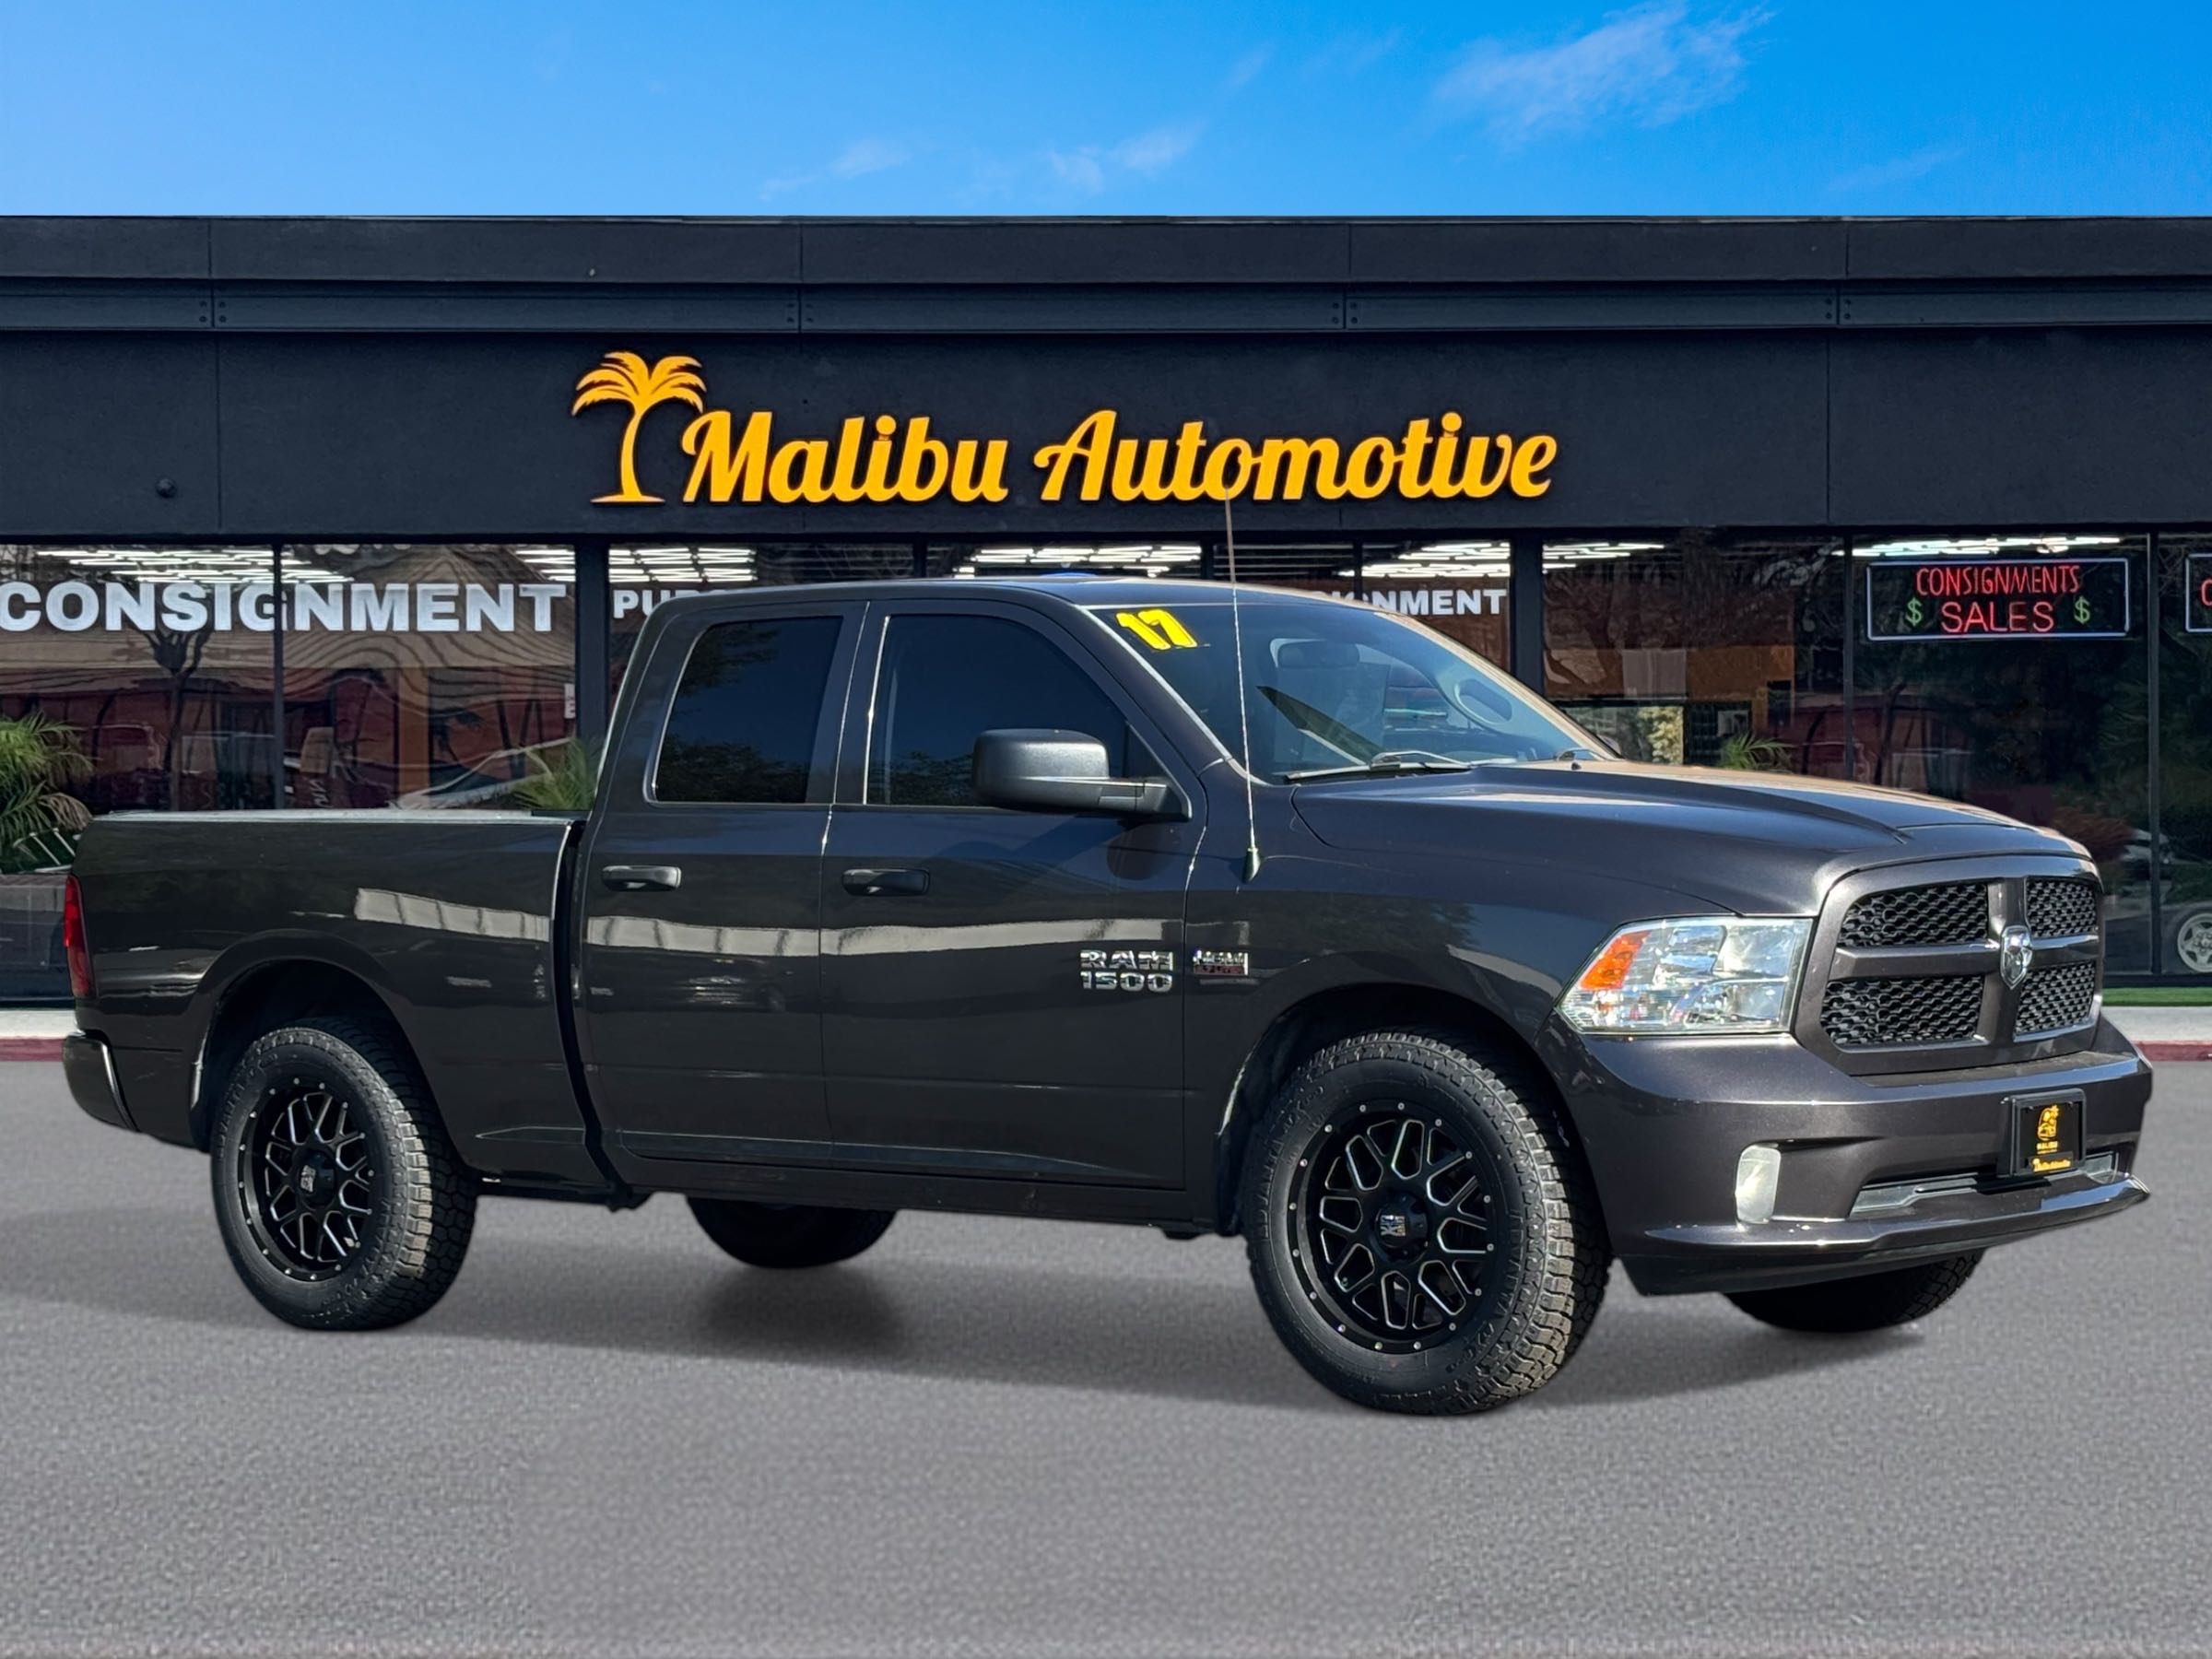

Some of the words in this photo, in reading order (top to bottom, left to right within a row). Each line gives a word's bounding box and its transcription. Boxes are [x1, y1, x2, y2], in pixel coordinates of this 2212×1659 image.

[681, 410, 1010, 504] Malibu
[1033, 408, 1558, 502] Automotive
[1915, 564, 2081, 596] CONSIGNMENTS
[0, 582, 567, 632] CONSIGNMENT
[1940, 601, 2055, 633] SALES
[1116, 609, 1198, 650] 17
[1080, 949, 1174, 971] RAM
[1080, 971, 1173, 993] 1500
